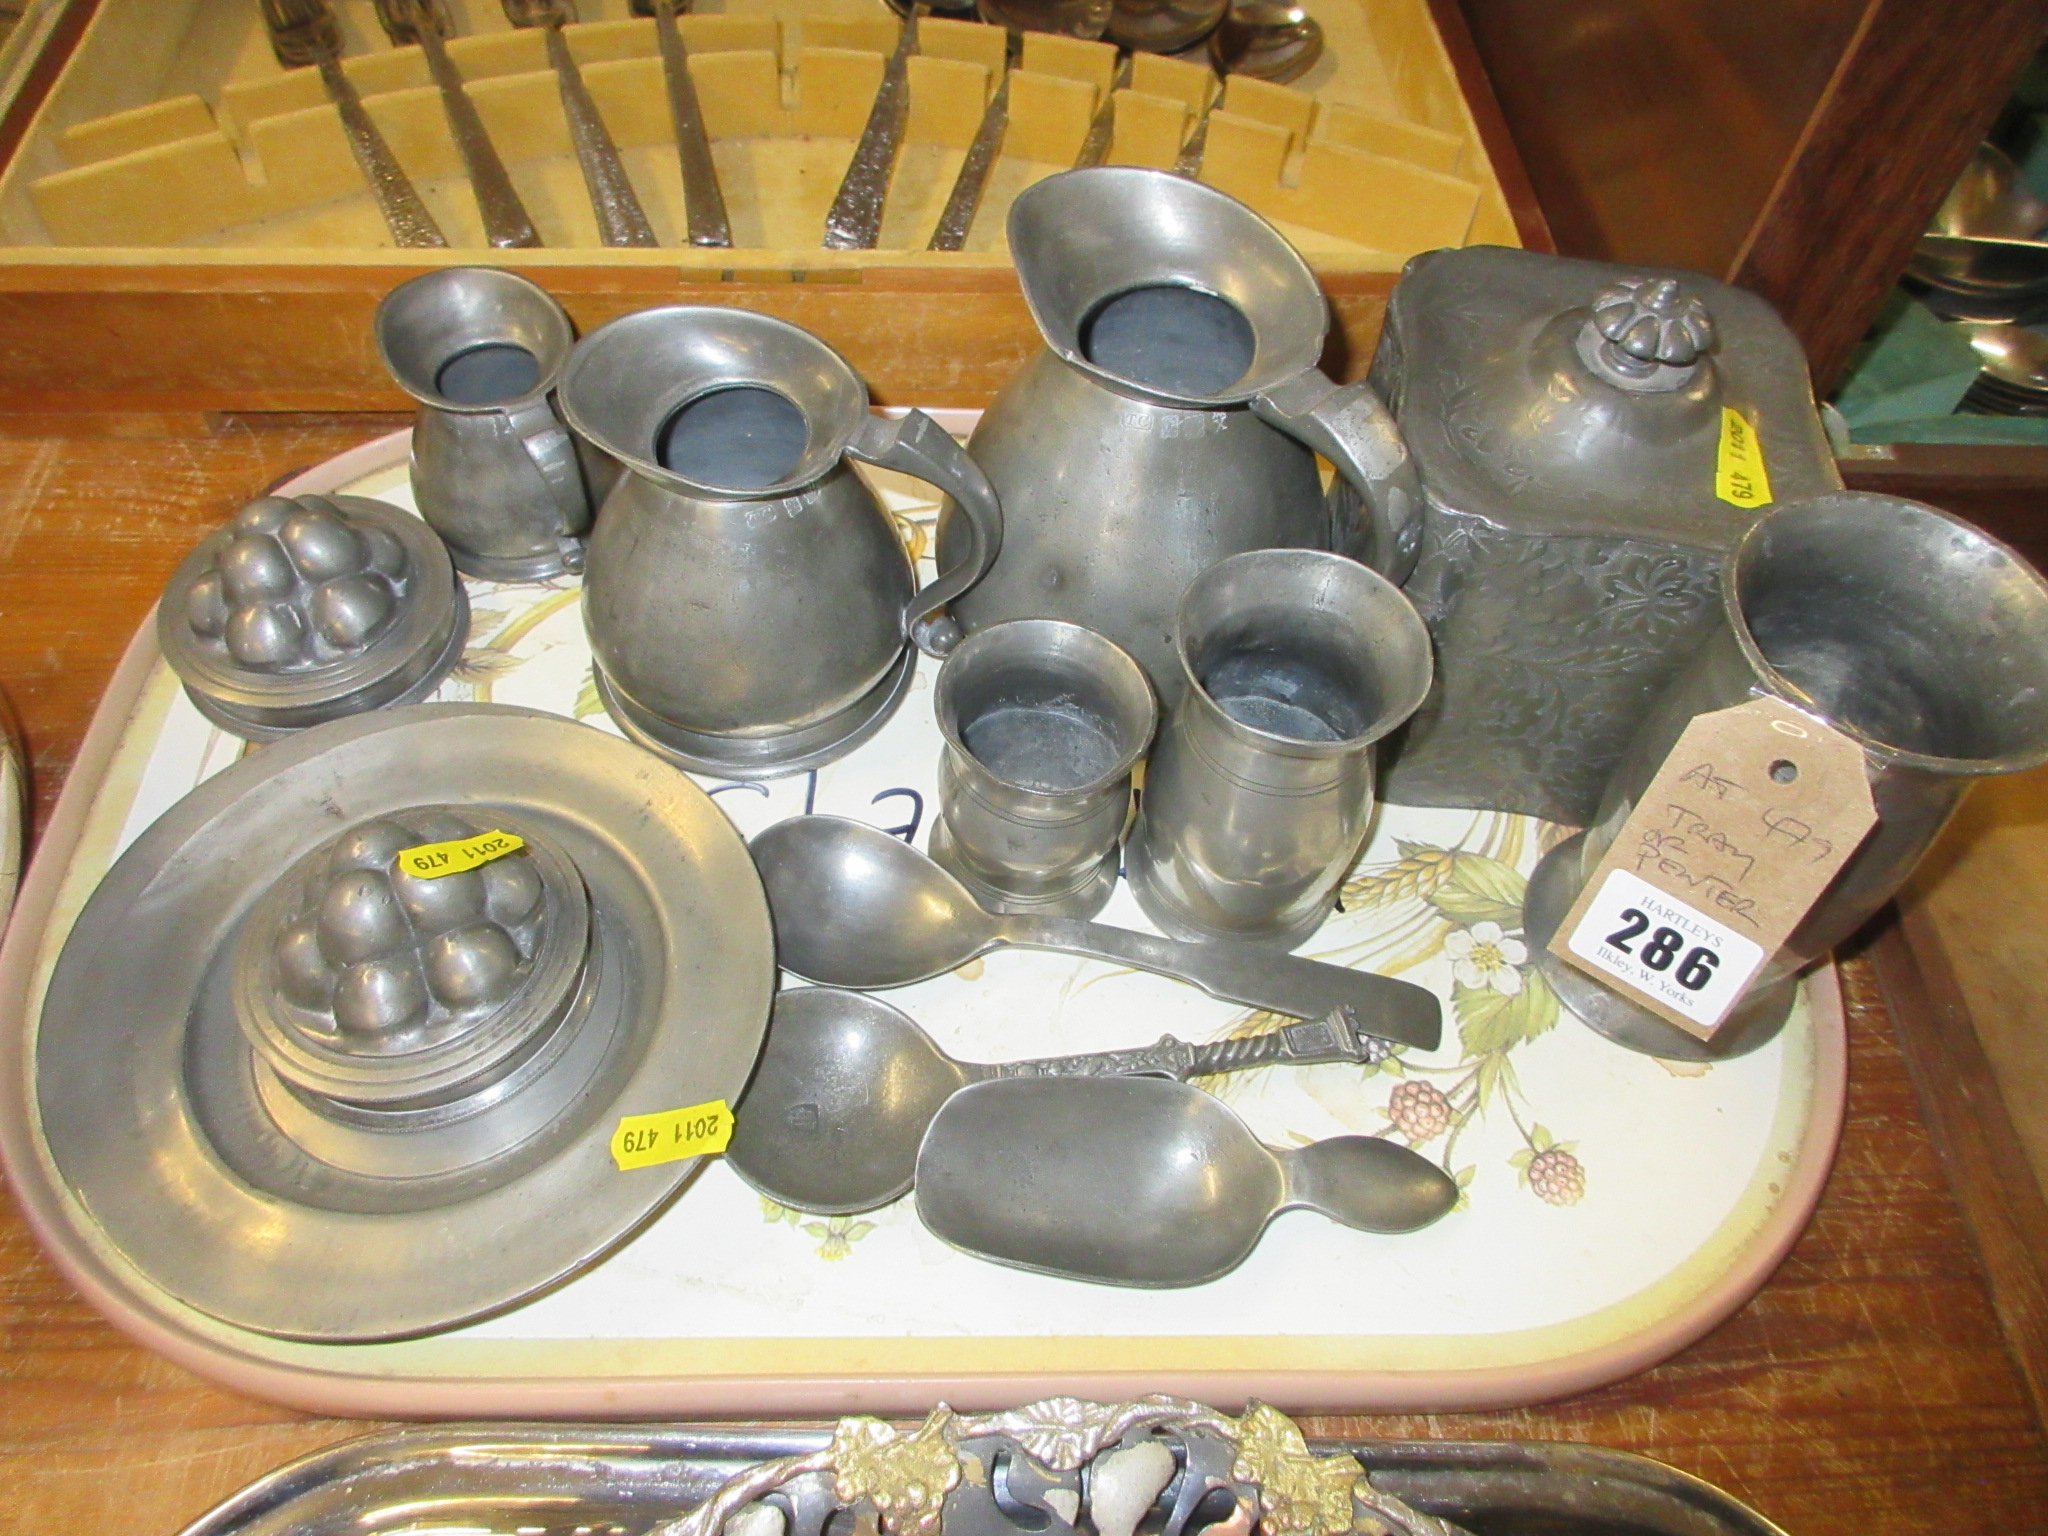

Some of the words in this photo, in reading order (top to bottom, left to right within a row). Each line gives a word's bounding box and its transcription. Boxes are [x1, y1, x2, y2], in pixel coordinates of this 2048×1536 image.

[1729, 418, 1746, 461] 2011
[1730, 471, 1755, 500] 479
[413, 852, 449, 870] 479
[462, 838, 510, 859] 2011
[1636, 842, 1760, 928] PEWTER
[1640, 896, 1723, 948] HARTLEYS
[1604, 907, 1721, 992] 286
[1659, 980, 1695, 1008] Yorks
[623, 1128, 659, 1153] 479
[674, 1114, 719, 1144] 2011
